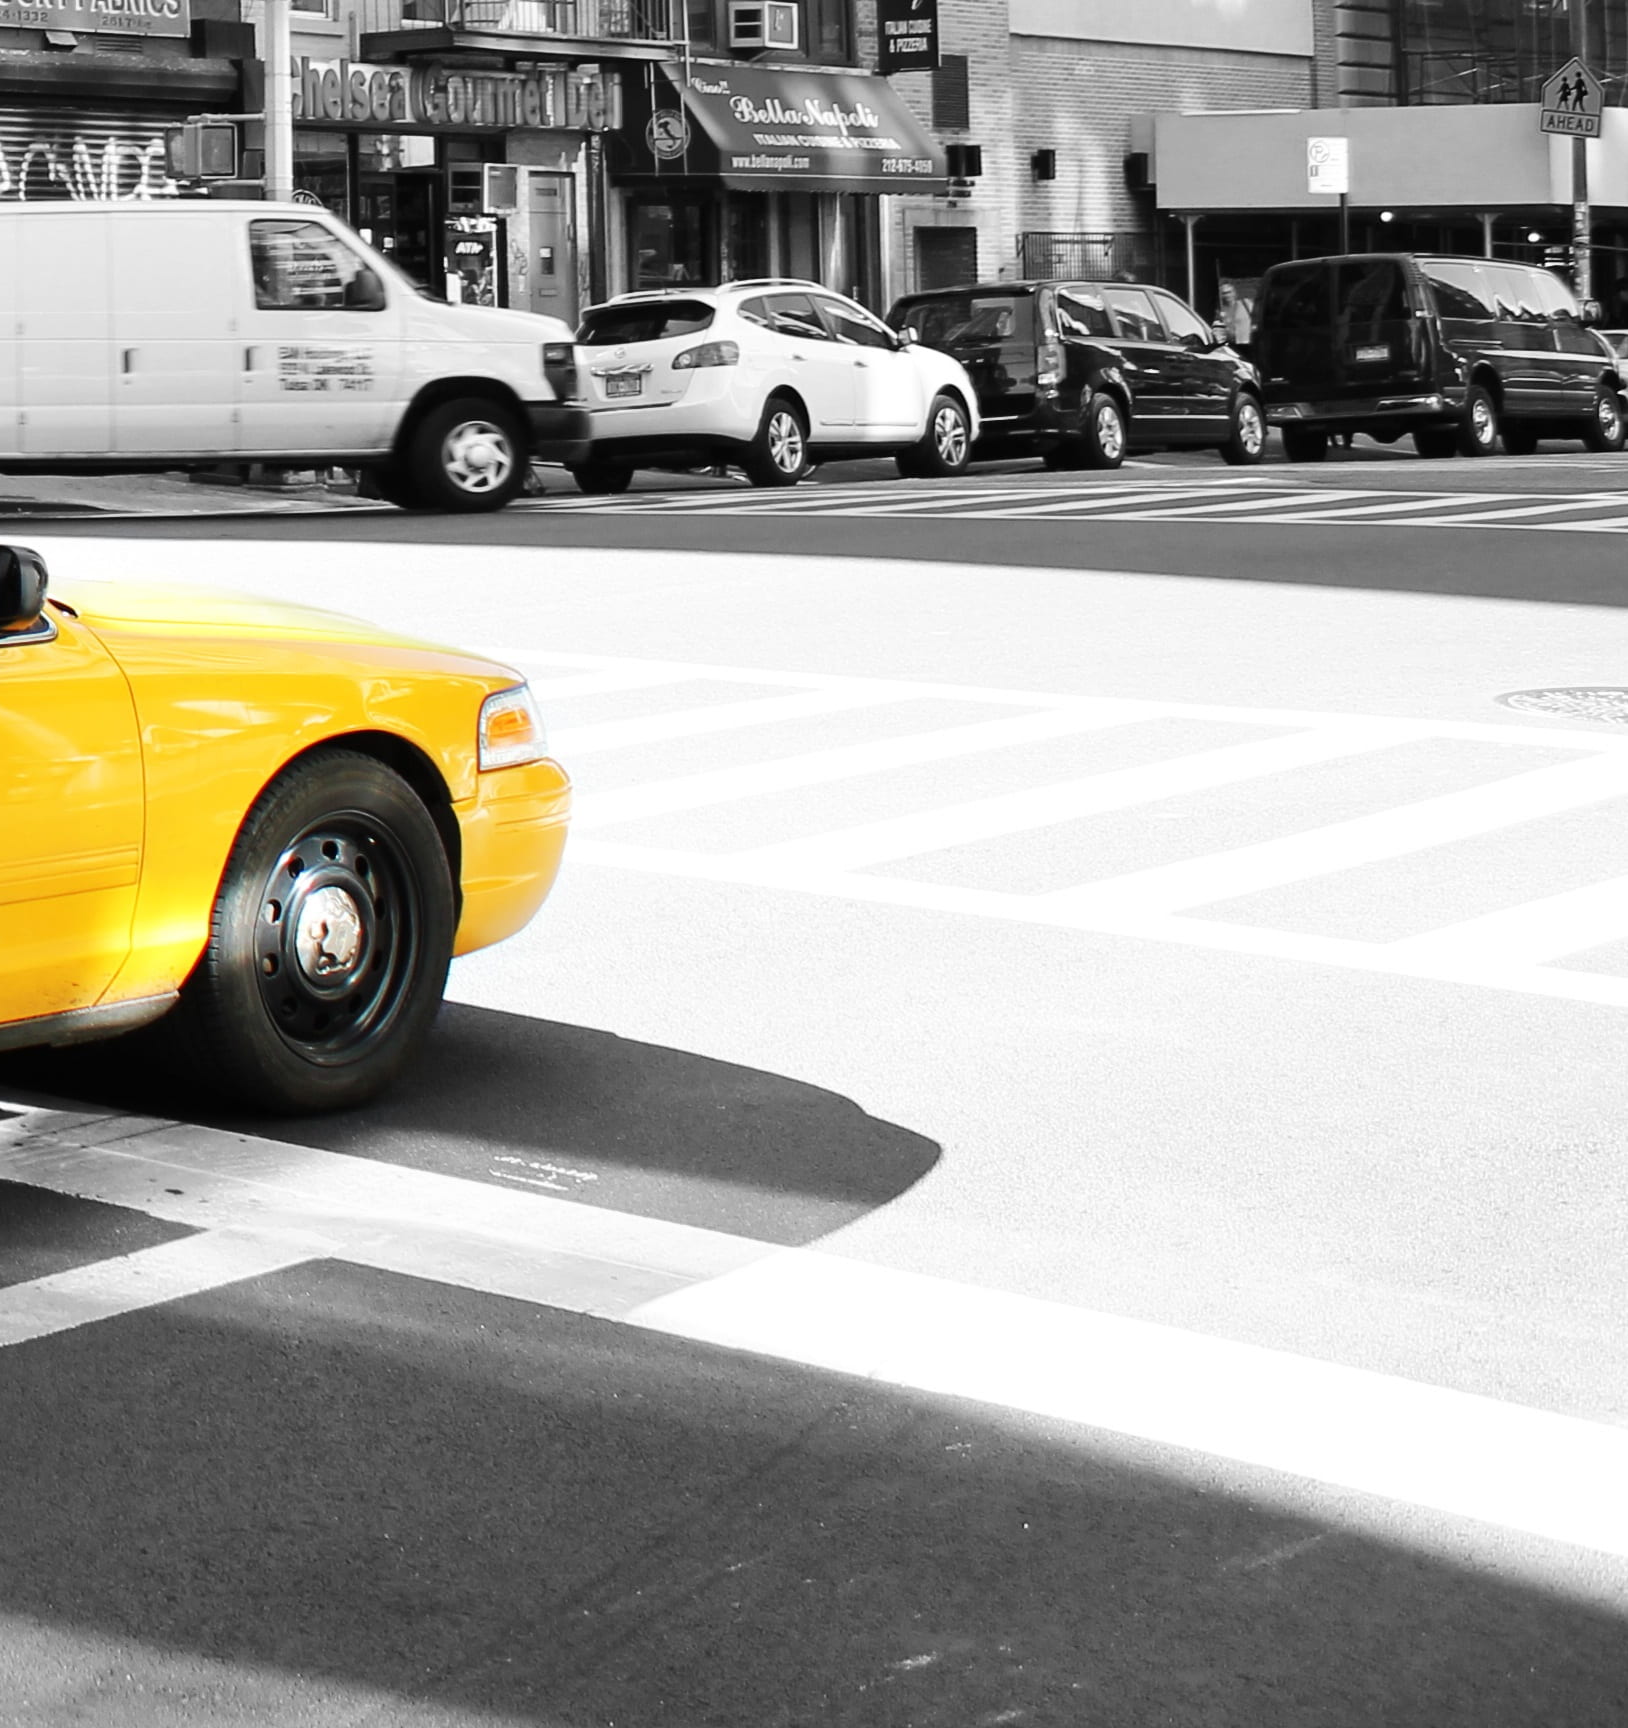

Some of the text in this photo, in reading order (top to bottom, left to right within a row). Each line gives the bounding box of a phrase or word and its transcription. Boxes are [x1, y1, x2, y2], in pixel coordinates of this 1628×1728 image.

[729, 94, 880, 138] Bella Napoli
[1546, 114, 1594, 133] AHEAD
